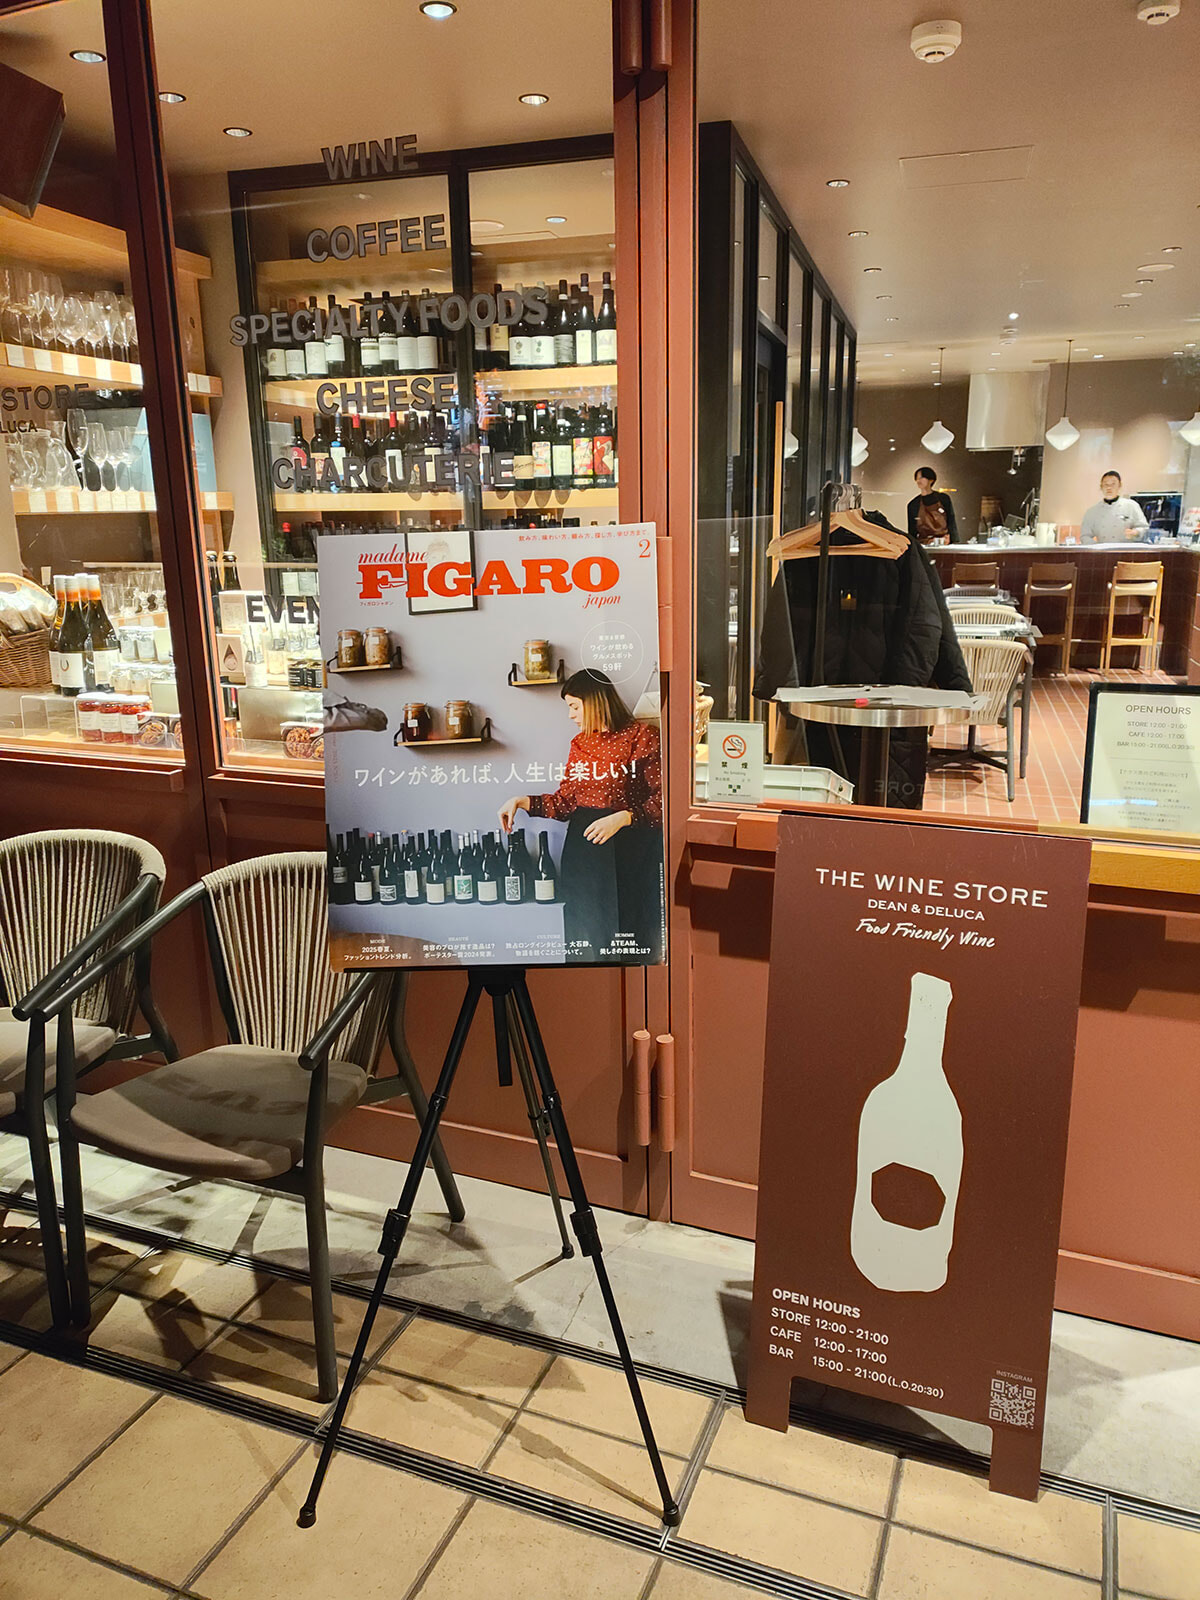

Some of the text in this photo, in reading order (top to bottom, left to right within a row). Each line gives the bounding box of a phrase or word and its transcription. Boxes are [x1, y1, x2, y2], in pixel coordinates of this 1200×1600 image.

[320, 134, 419, 181] WINE
[306, 213, 447, 263] COFFEE
[229, 287, 549, 347] SPECIALTY FOODS
[1, 383, 89, 411] STORE
[316, 375, 456, 415] CHEESE
[271, 451, 515, 490] CHARCUTERIE
[358, 543, 428, 564] madame
[638, 539, 651, 558] 2
[355, 556, 620, 600] FIGARO
[582, 594, 621, 609] japon
[602, 662, 622, 672] 59軒
[1125, 704, 1191, 715] OPEN HOURS
[815, 867, 1049, 908] THE WINE STORE
[867, 898, 985, 921] DEAN & DELUCA
[856, 918, 996, 950] Food Friendly Wine
[772, 1287, 861, 1319] OPEN HOURS
[771, 1307, 811, 1326] STORE
[815, 1317, 847, 1335] 12:00
[856, 1328, 889, 1345] 21:00
[769, 1343, 794, 1360] BAR
[812, 1355, 843, 1373] 15:00
[770, 1325, 802, 1343] CAFE
[813, 1336, 845, 1354] 12:00
[855, 1347, 887, 1364] 17:00
[996, 1369, 1033, 1383] INSTAGRAM
